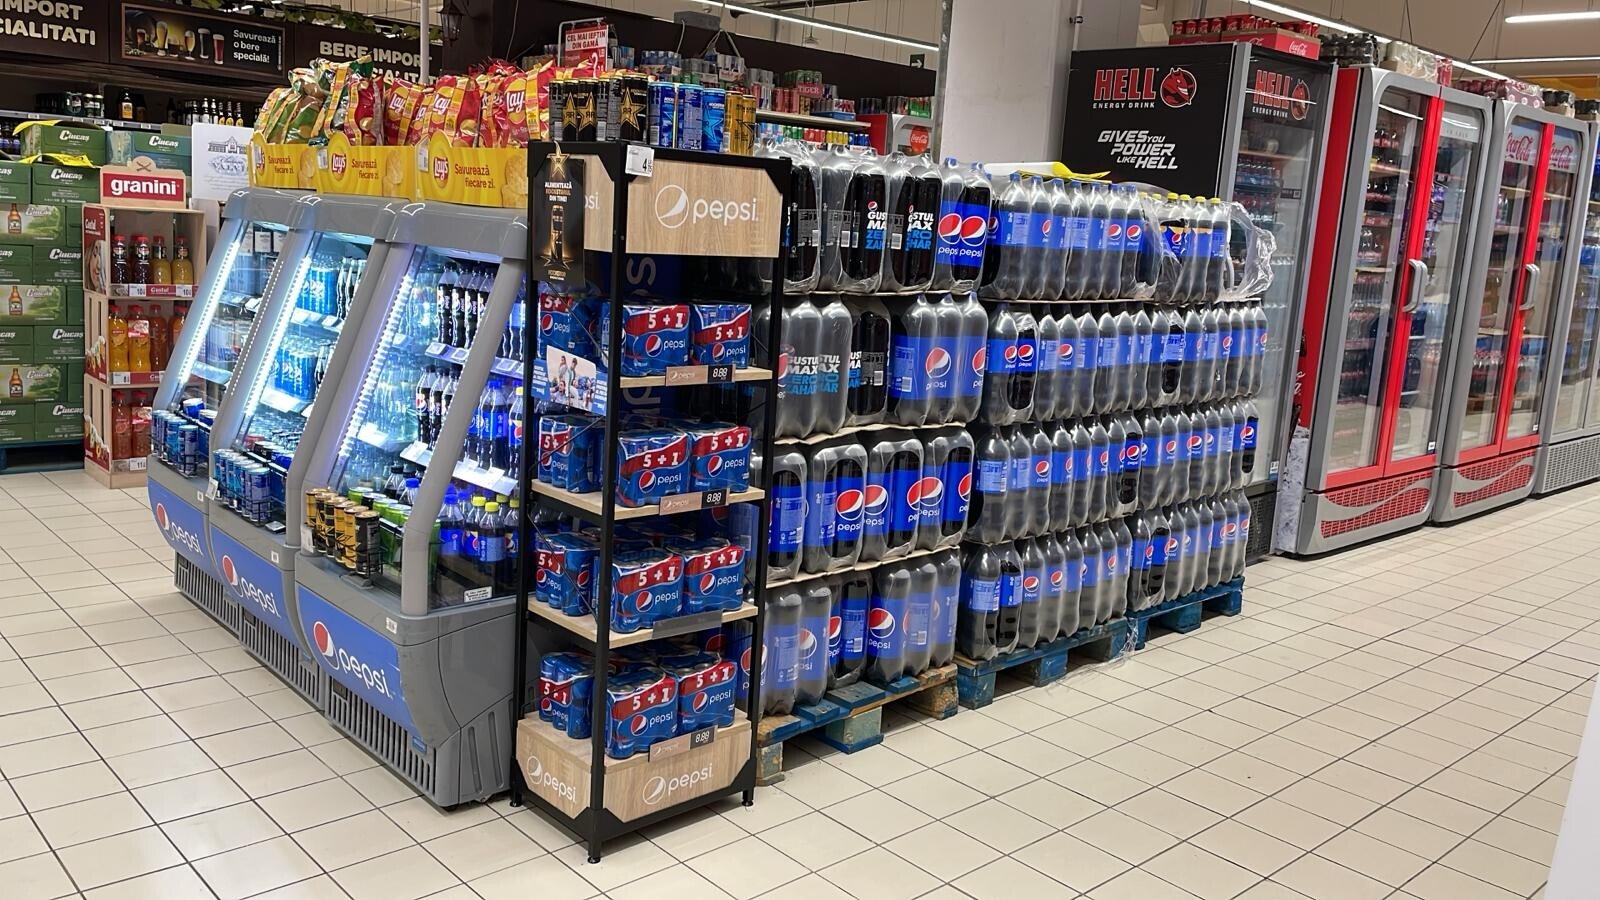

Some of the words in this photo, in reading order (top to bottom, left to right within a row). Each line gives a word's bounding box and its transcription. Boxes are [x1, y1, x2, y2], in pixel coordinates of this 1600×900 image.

[241, 40, 260, 51] bere
[319, 41, 368, 58] BERE
[372, 48, 433, 67] IMPOR
[1093, 67, 1157, 100] HELL
[1253, 69, 1291, 109] HELL
[389, 93, 405, 112] Lay
[432, 94, 451, 114] Lay
[506, 91, 525, 113] Lay
[1097, 130, 1150, 142] GIVES
[1110, 143, 1176, 156] POWER
[1134, 156, 1178, 169] HELL
[110, 177, 177, 196] granini
[692, 198, 758, 226] pepsi
[867, 212, 888, 220] GUS
[866, 220, 888, 229] MA
[911, 220, 933, 230] AX
[648, 315, 656, 328] 5
[662, 315, 671, 326] +
[676, 313, 684, 327] 1
[715, 328, 722, 340] 5
[726, 328, 734, 339] +
[737, 326, 744, 338] 1
[663, 339, 686, 351] pepsi
[726, 347, 746, 357] pepsi
[711, 437, 718, 450] 5
[724, 436, 732, 445] +
[736, 433, 743, 447] 1
[643, 454, 652, 467] 5
[657, 454, 667, 464] +
[672, 452, 679, 465] 1
[724, 457, 746, 470] pepsi
[657, 473, 682, 486] pepsi
[837, 523, 862, 532] pepsi
[171, 522, 201, 552] pepsi
[703, 557, 711, 569] 5
[717, 553, 726, 564] +
[730, 550, 738, 564] 1
[638, 574, 647, 587] 5
[654, 571, 663, 581] +
[667, 567, 676, 581] 1
[716, 575, 740, 587] pepsi
[240, 577, 281, 617] pepsi
[654, 591, 680, 604] pepsi
[338, 648, 391, 698] pepsi
[696, 674, 704, 687] 5
[710, 671, 717, 681] +
[721, 666, 730, 680] 1
[543, 683, 550, 696] 5
[709, 690, 731, 703] pepsi
[632, 696, 641, 710] 5
[647, 693, 657, 703] +
[662, 688, 671, 702] 1
[551, 708, 568, 721] peps
[649, 712, 674, 727] pepsi
[543, 771, 577, 802] pepsi
[668, 763, 713, 795] pepsi
